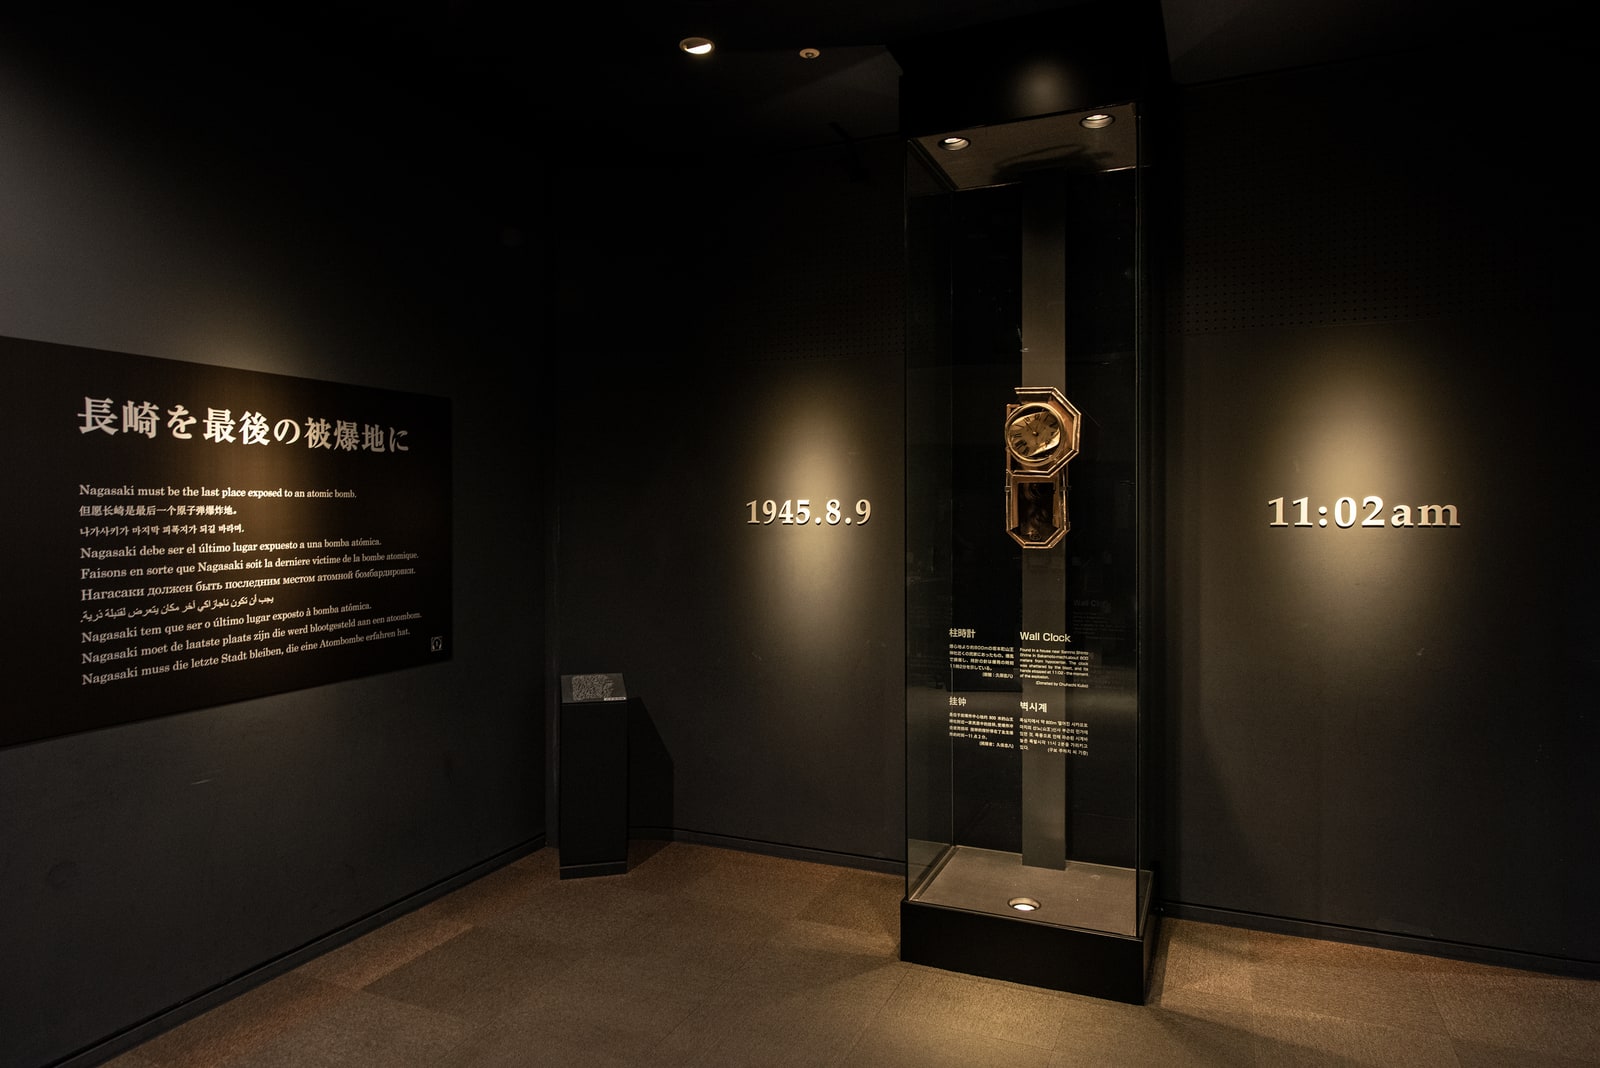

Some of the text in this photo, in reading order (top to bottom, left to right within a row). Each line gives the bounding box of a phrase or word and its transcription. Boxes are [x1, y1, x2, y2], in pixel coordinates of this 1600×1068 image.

[77, 396, 410, 452] 長崎を最後の被爆地に
[79, 484, 134, 497] Nagasaki
[138, 487, 165, 496] must
[167, 485, 180, 496] be
[182, 486, 199, 496] the
[201, 486, 220, 497] last
[221, 486, 246, 499] place
[247, 487, 283, 499] exposed
[284, 489, 293, 498] to
[307, 489, 333, 498] atomic
[334, 488, 357, 498] bomb.
[746, 499, 871, 525] 1945.8.9
[1268, 496, 1461, 527] 11:02am
[80, 545, 136, 560] Nagasaki
[139, 544, 165, 556] debe
[168, 546, 184, 555] ser
[186, 543, 196, 554] el
[198, 542, 231, 554] último
[232, 541, 258, 554] lugar
[259, 541, 298, 552] expuesto
[324, 538, 350, 548] bomba
[351, 537, 382, 547] atómica.
[81, 567, 127, 580] Faisons
[129, 568, 143, 576] en
[146, 565, 174, 576] sorte
[176, 565, 195, 575] que
[198, 559, 244, 574] Nagasaki
[245, 558, 263, 569] soit
[264, 558, 273, 568] la
[312, 555, 341, 565] victime
[342, 554, 352, 563] de
[353, 553, 360, 562] la
[362, 552, 385, 562] bombe
[386, 551, 419, 561] atomique.
[81, 588, 144, 601] Нагасаки
[147, 584, 193, 597] должен
[195, 580, 223, 592] быть
[225, 577, 281, 590] последним
[282, 575, 315, 585] местом
[317, 570, 353, 582] атомной
[82, 626, 137, 643] Nagasaki
[140, 626, 162, 636] tem
[164, 624, 184, 635] que
[186, 622, 203, 631] ser
[213, 616, 245, 628] último
[246, 614, 271, 624] lugar
[272, 610, 304, 622] exposto
[313, 604, 339, 616] bomba
[949, 628, 976, 638] 柱時計
[1020, 631, 1071, 642] Wall Clock
[82, 646, 138, 664] Nagasaki
[141, 644, 168, 656] moet
[170, 641, 183, 652] de
[185, 638, 220, 650] laatste
[222, 634, 252, 647] plaats
[253, 630, 270, 642] zijn
[272, 628, 286, 638] die
[287, 624, 308, 636] werd
[310, 618, 356, 633] blootgesteld
[357, 618, 371, 626] aan
[82, 628, 410, 685] Nagasaki muss die letzte Stadt bleiben, die eine Atombombe erfahren hat.
[949, 696, 967, 706] 挂钟
[1020, 701, 1048, 713] 벽시계
